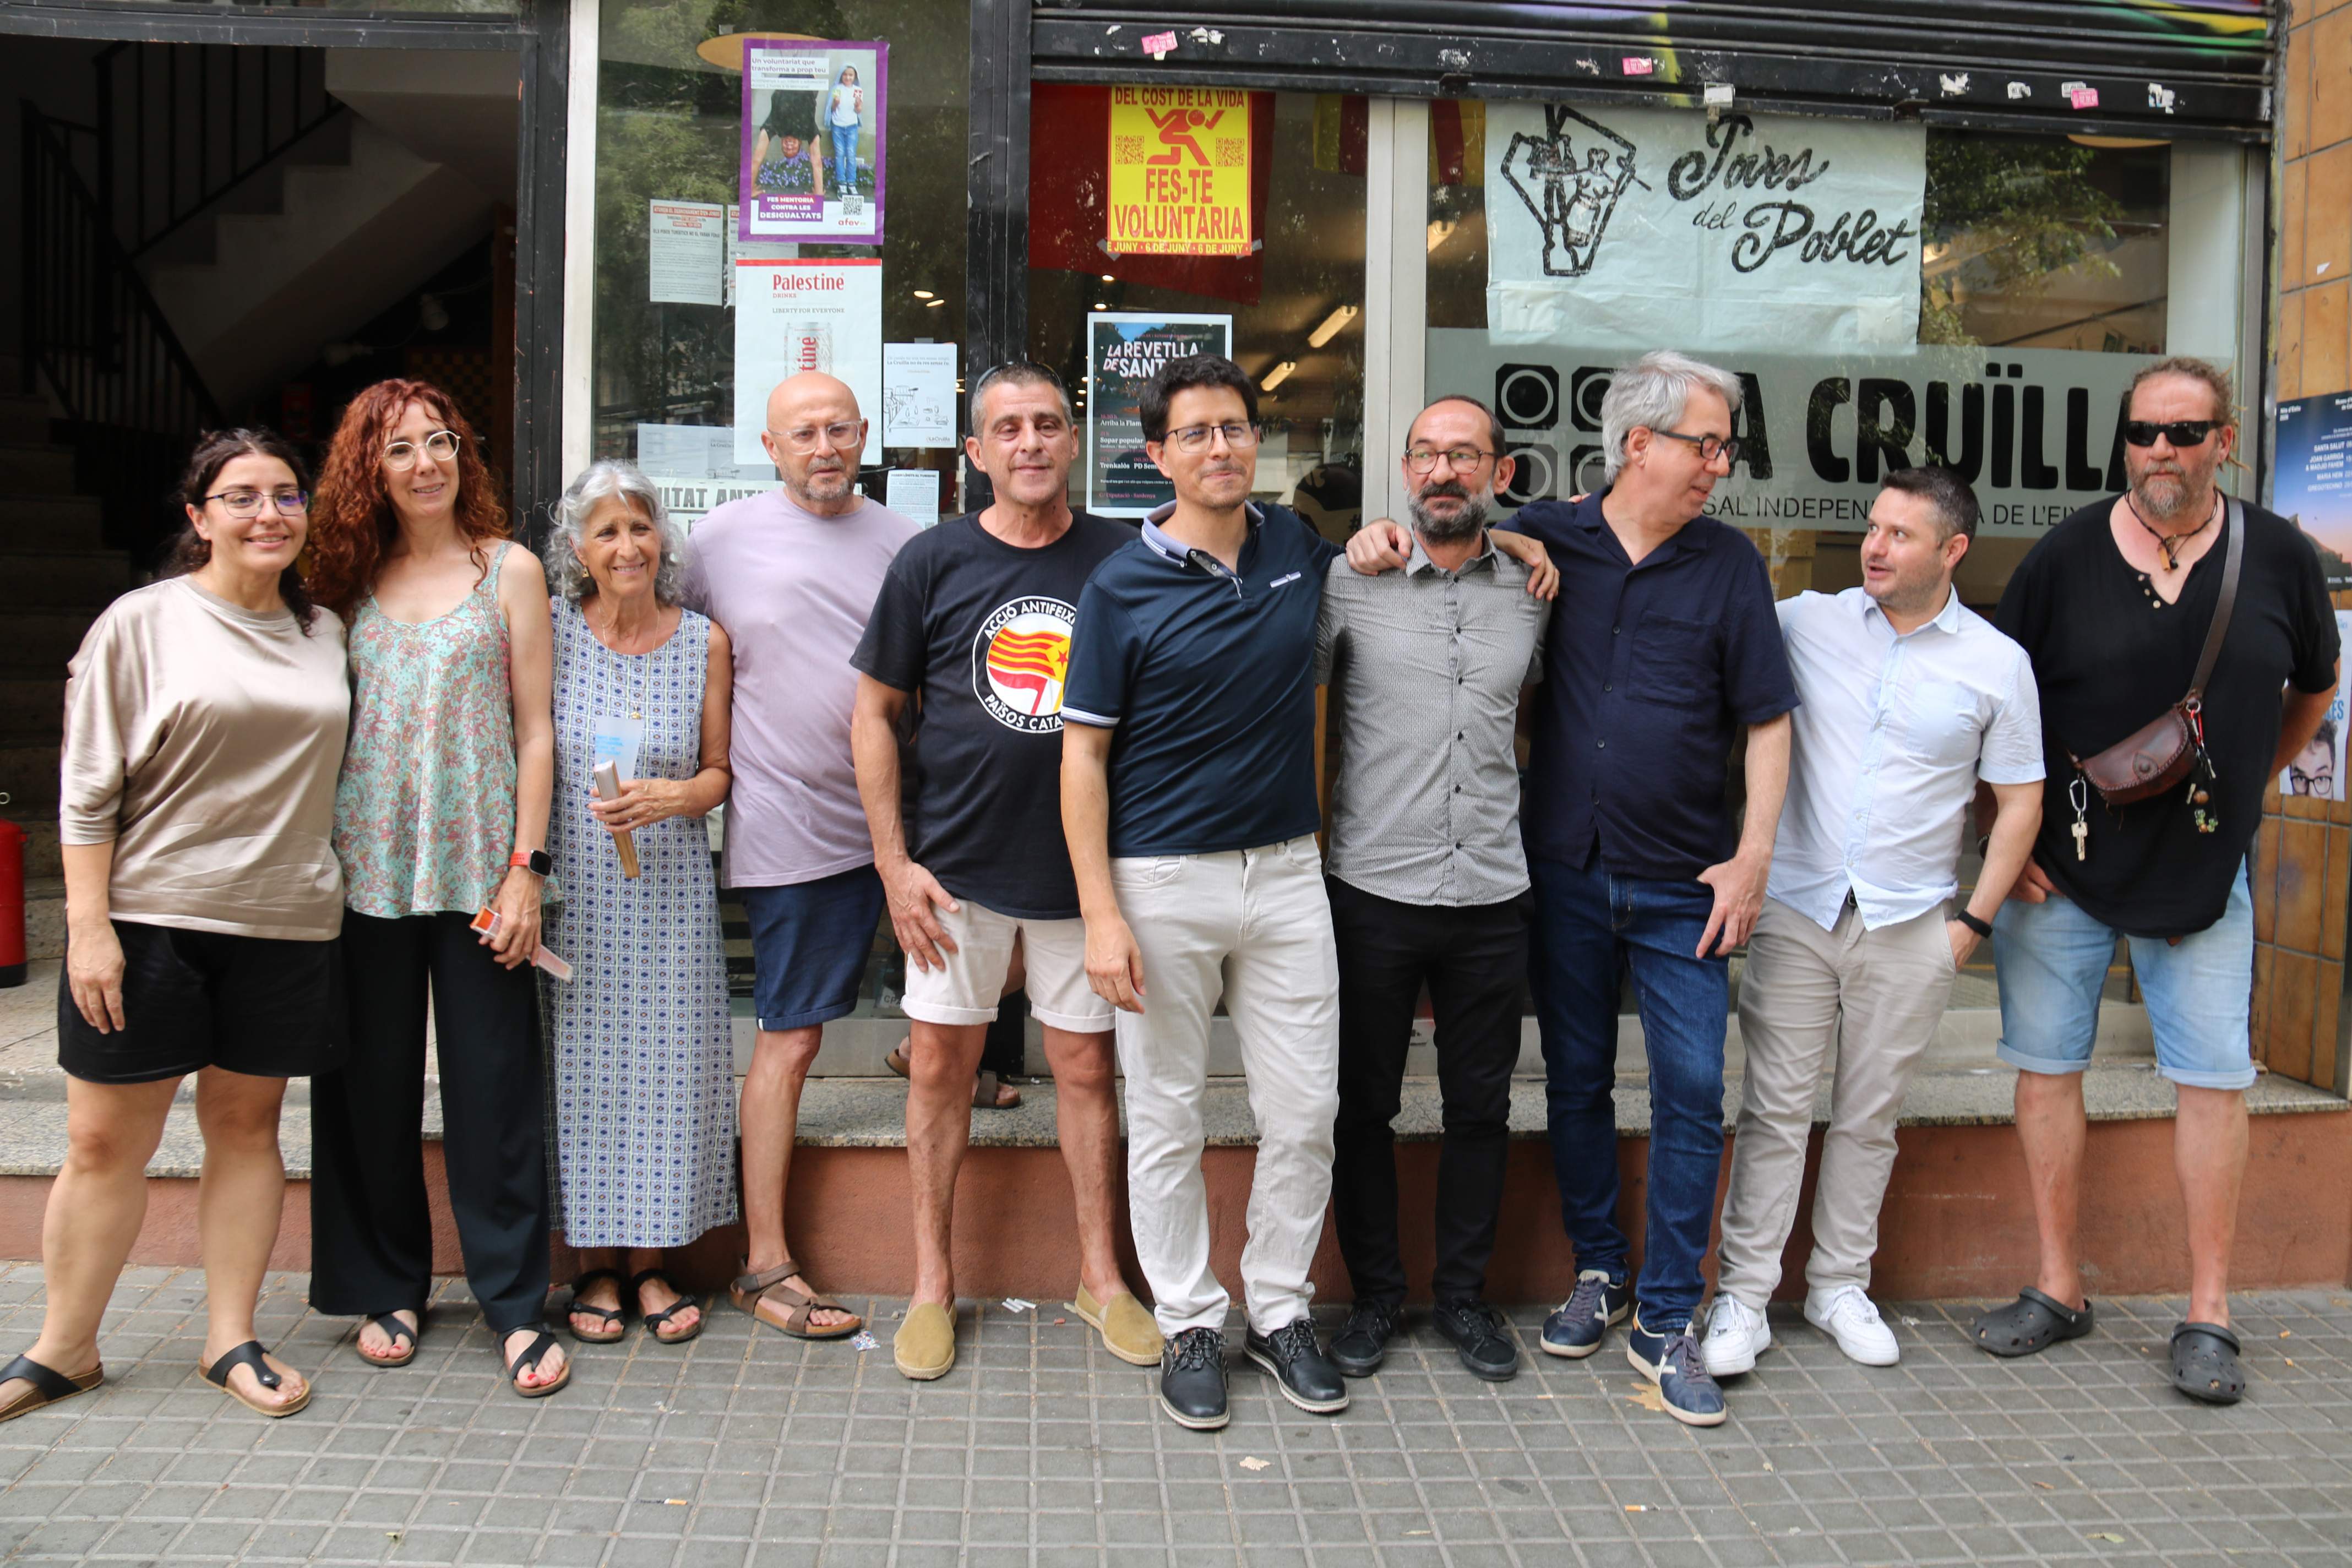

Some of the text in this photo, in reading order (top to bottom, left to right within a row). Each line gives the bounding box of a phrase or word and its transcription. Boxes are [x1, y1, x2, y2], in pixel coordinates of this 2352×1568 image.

[1115, 87, 1244, 107] DEL COST DE LA VIDA
[1668, 113, 1830, 201] Joves
[1146, 168, 1213, 204] FES-TE
[1114, 200, 1244, 239] VOLUNTÀRIA
[1692, 199, 1917, 273] del Poblet
[1114, 241, 1137, 252] JUNY
[1145, 242, 1150, 252] 6
[1153, 242, 1164, 252] DE
[1167, 243, 1190, 253] JUNY
[1199, 244, 1203, 253] 6
[1206, 244, 1217, 253] DE
[1219, 244, 1244, 254] JUNY
[773, 273, 844, 290] Palestine
[798, 336, 816, 371] tine
[1107, 341, 1198, 358] LA REVETLLA
[1103, 358, 1167, 378] DE SANT
[1702, 496, 1748, 516] SAL
[1757, 496, 1875, 520] INDEPEN
[1994, 504, 2024, 525] DE
[2033, 505, 2075, 526] L'EI
[984, 605, 1017, 640] ACCIÓ
[984, 694, 1064, 729] PAÏSOS CATA
